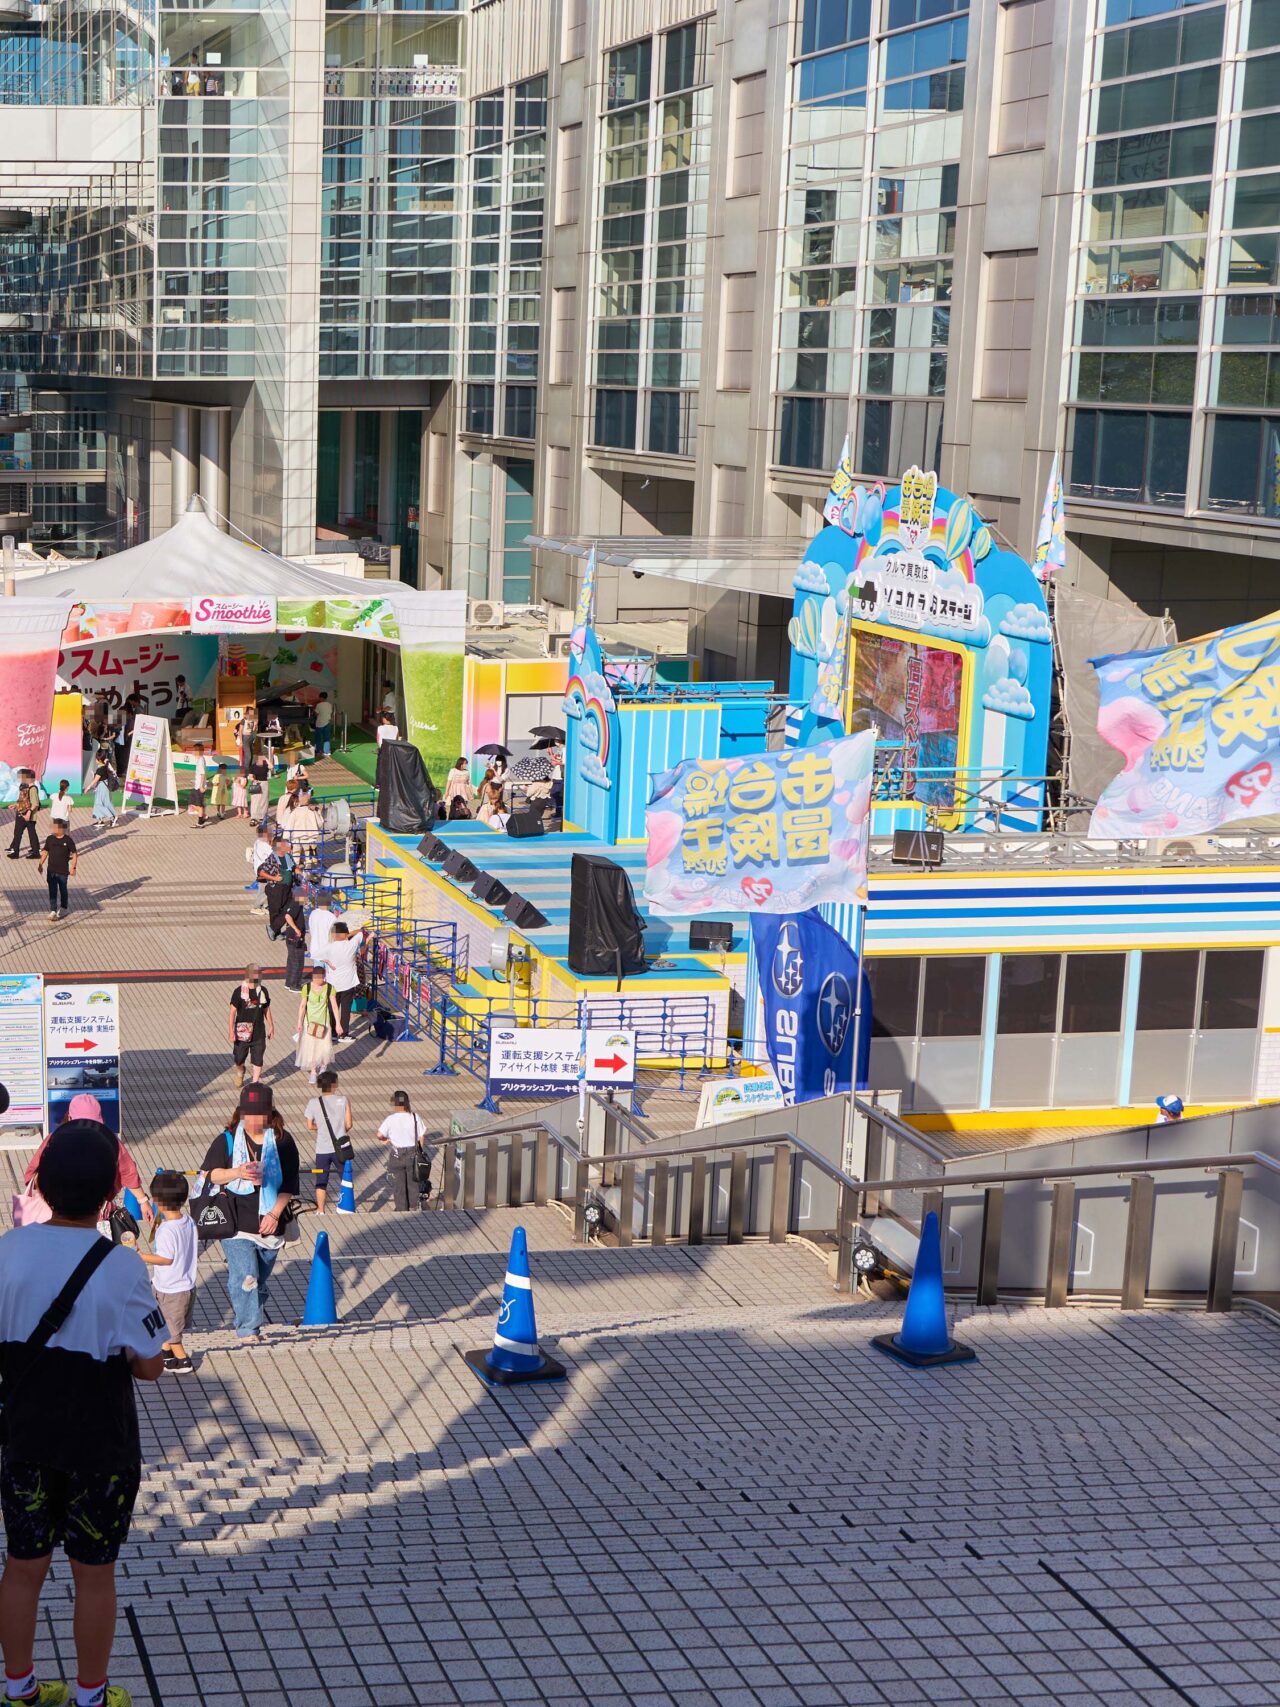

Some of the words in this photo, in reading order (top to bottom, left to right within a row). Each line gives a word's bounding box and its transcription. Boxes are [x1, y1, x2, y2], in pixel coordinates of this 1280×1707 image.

[885, 559, 929, 580] クルマ買取は
[194, 598, 272, 622] Smoothie
[214, 602, 244, 610] スムージー
[884, 587, 926, 611] ソコカラ
[939, 599, 972, 621] ステージ
[57, 642, 180, 680] スムージー
[51, 1015, 114, 1025] 運転支援システム
[49, 1025, 94, 1034] アイサイト体験
[96, 1024, 116, 1033] 実施中
[499, 1062, 558, 1073] アイサイト体験
[743, 1090, 782, 1103] スケジュール
